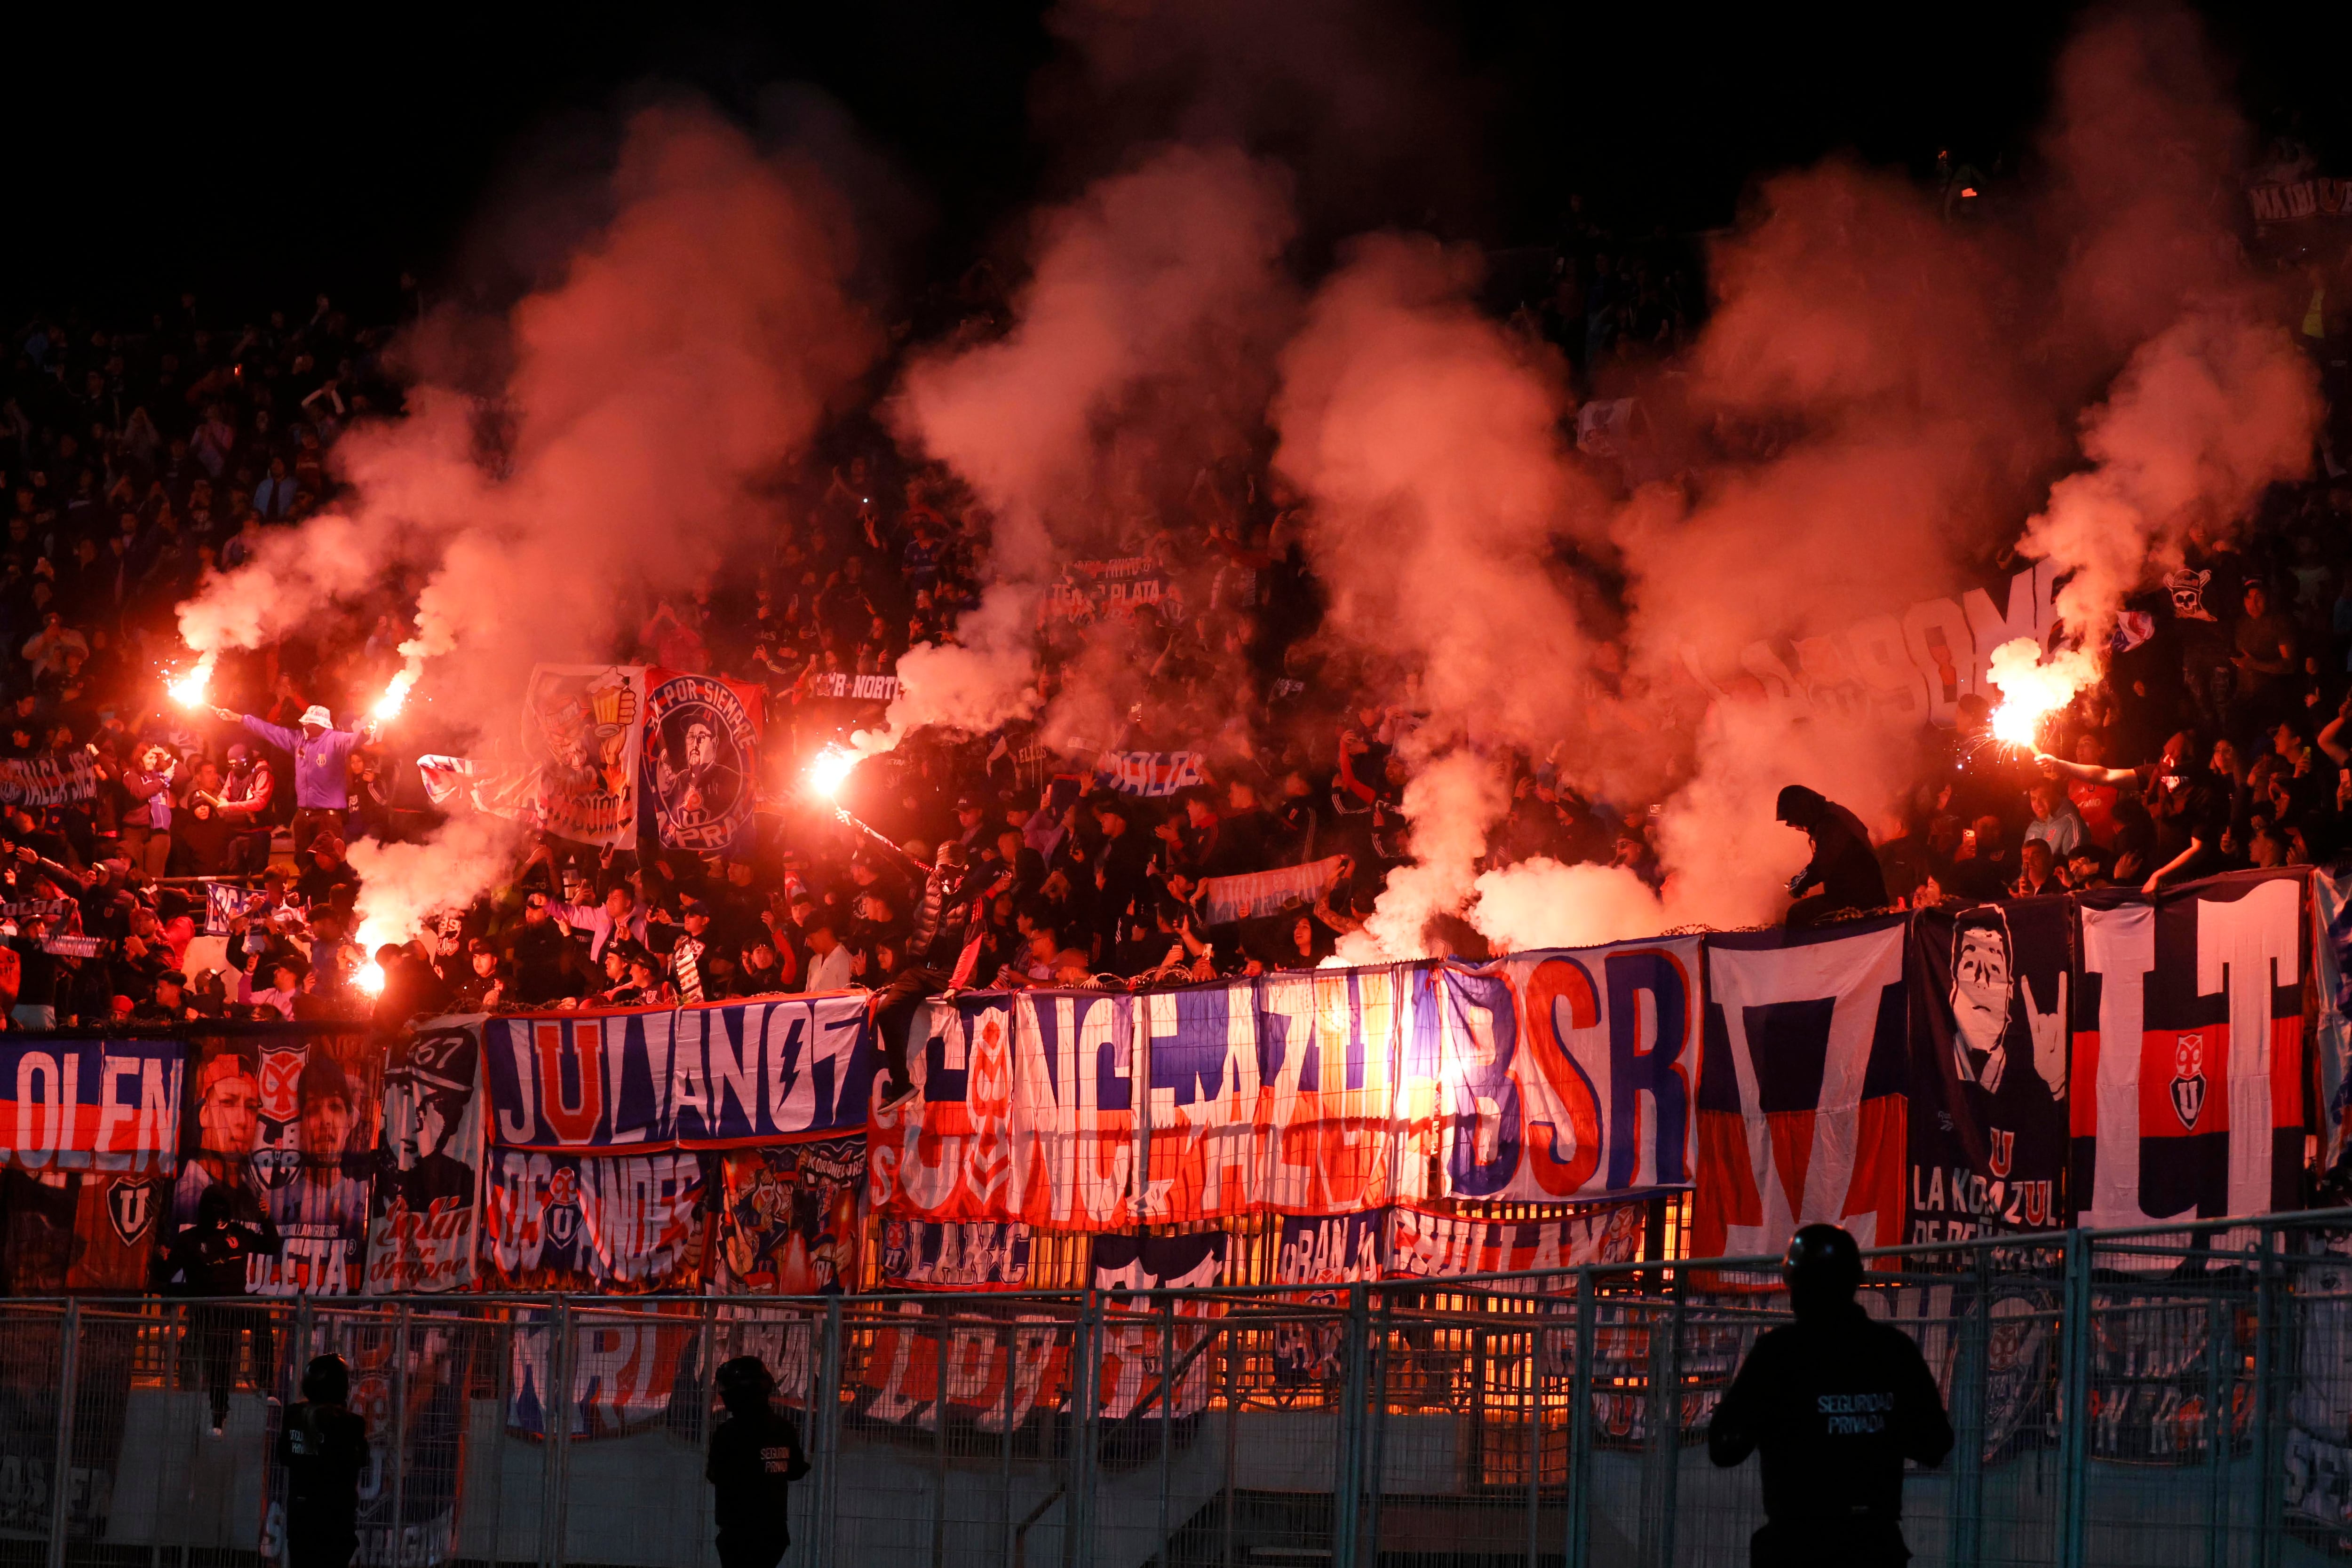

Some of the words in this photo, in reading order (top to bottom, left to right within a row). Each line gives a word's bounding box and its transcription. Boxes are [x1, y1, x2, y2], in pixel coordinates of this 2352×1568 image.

[664, 679, 699, 708] POR
[704, 682, 759, 750] SIEMPRE
[1448, 949, 1692, 1197] BSR
[0, 1050, 185, 1173] OLEN
[119, 1189, 151, 1233] U
[1913, 1164, 1945, 1212] LA
[556, 1208, 574, 1241] U
[1817, 1392, 1894, 1414] SEGURIDAD
[1827, 1415, 1885, 1434] PRIVADA
